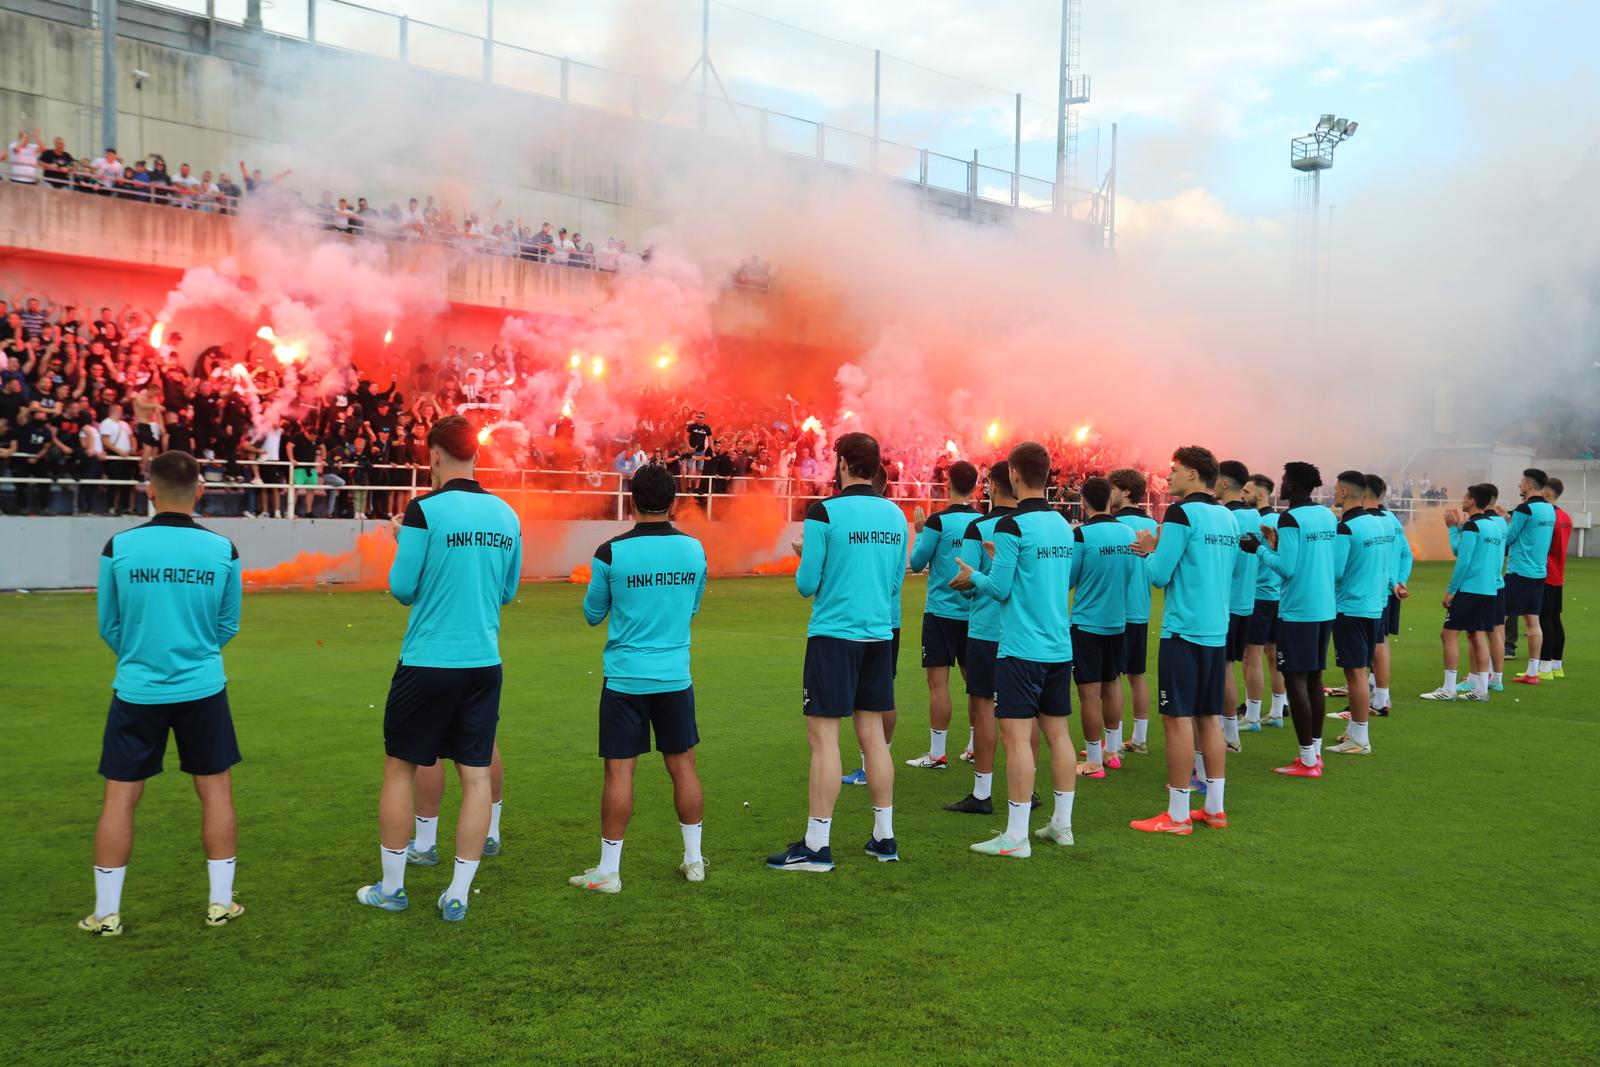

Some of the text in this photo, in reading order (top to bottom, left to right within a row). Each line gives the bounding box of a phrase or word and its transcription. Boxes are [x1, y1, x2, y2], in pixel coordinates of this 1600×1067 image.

[447, 531, 513, 552] HNK RIJEKA
[848, 531, 901, 546] HNK RIJEKA
[952, 539, 962, 548] HN
[1099, 546, 1116, 556] HNK
[129, 568, 215, 586] HNK RIJEKA
[627, 571, 696, 589] HNK RIJEKA
